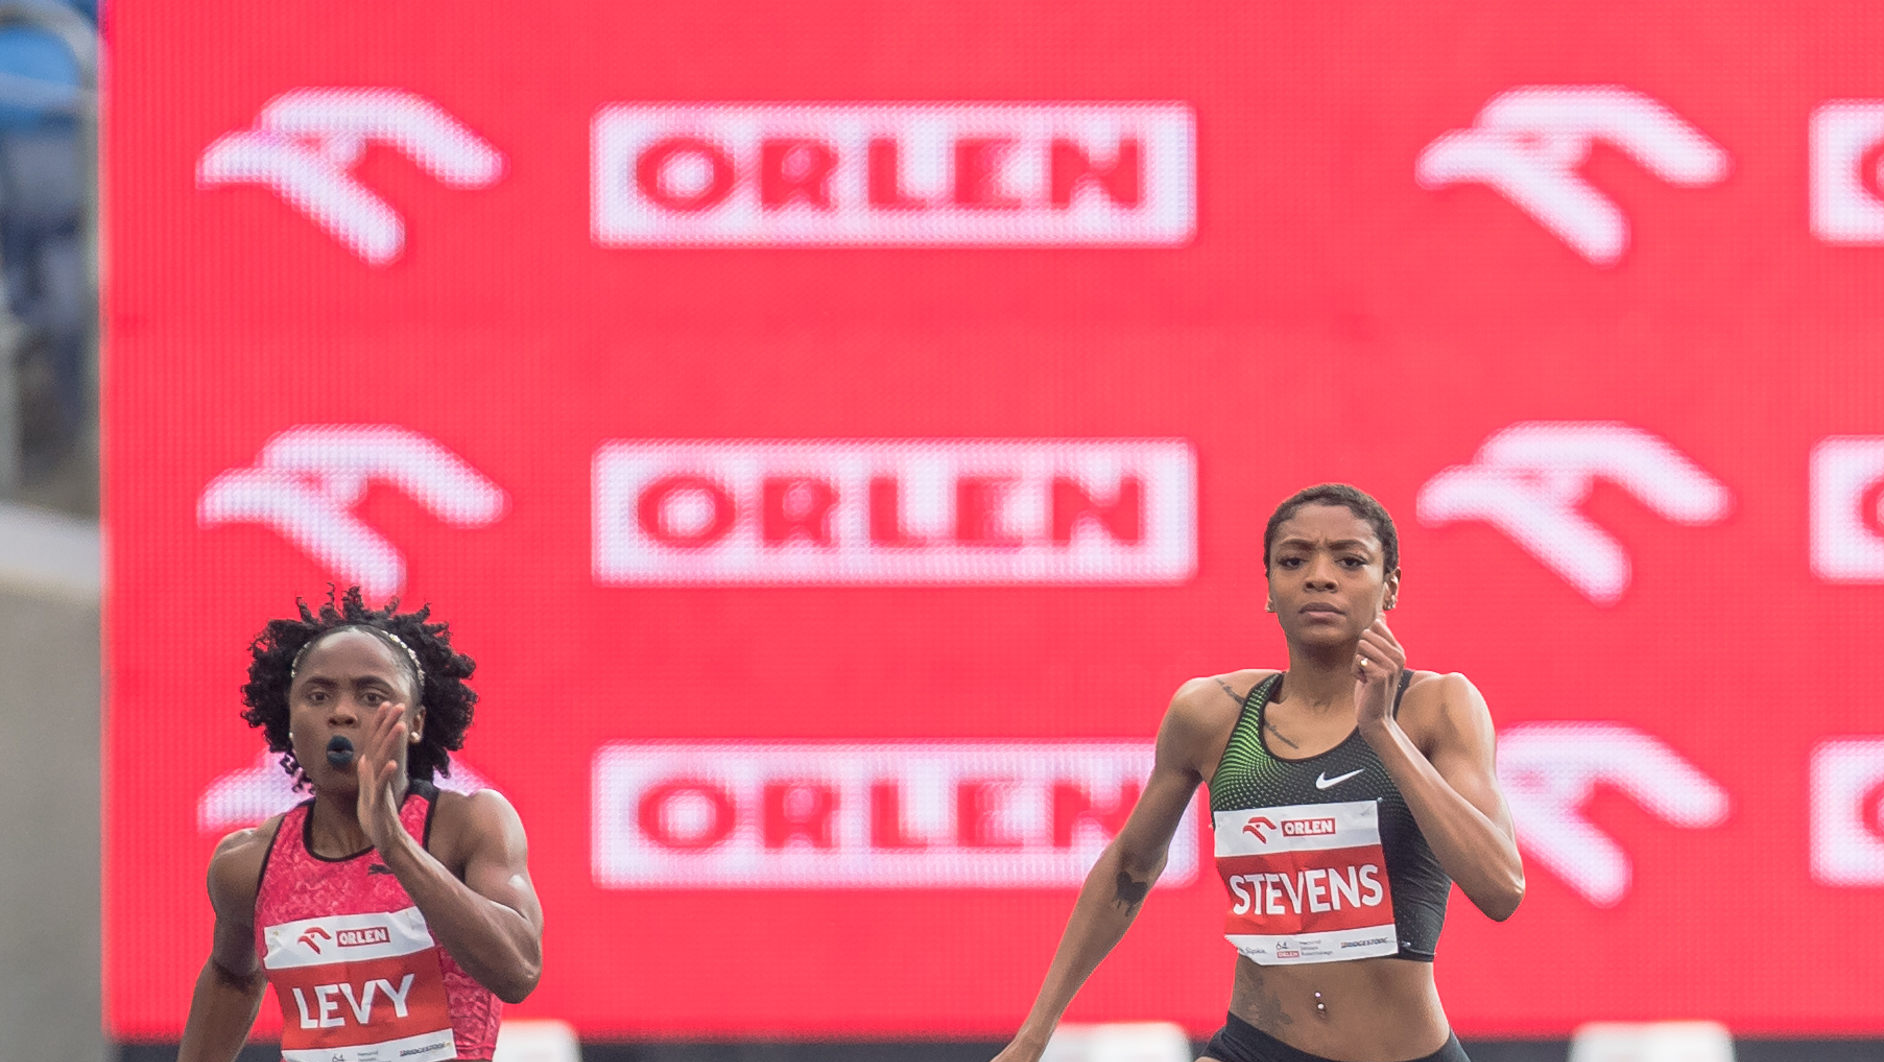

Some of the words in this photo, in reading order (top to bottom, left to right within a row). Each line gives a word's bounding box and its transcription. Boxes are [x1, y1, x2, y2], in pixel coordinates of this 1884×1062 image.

[636, 136, 1142, 213] ORLEN
[636, 474, 1142, 549] ORLEN
[637, 777, 1141, 852] ORLEN
[1284, 820, 1333, 836] ORLEN
[1229, 864, 1383, 915] STEVENS
[339, 929, 387, 945] ORLEN
[292, 973, 415, 1029] LEVY
